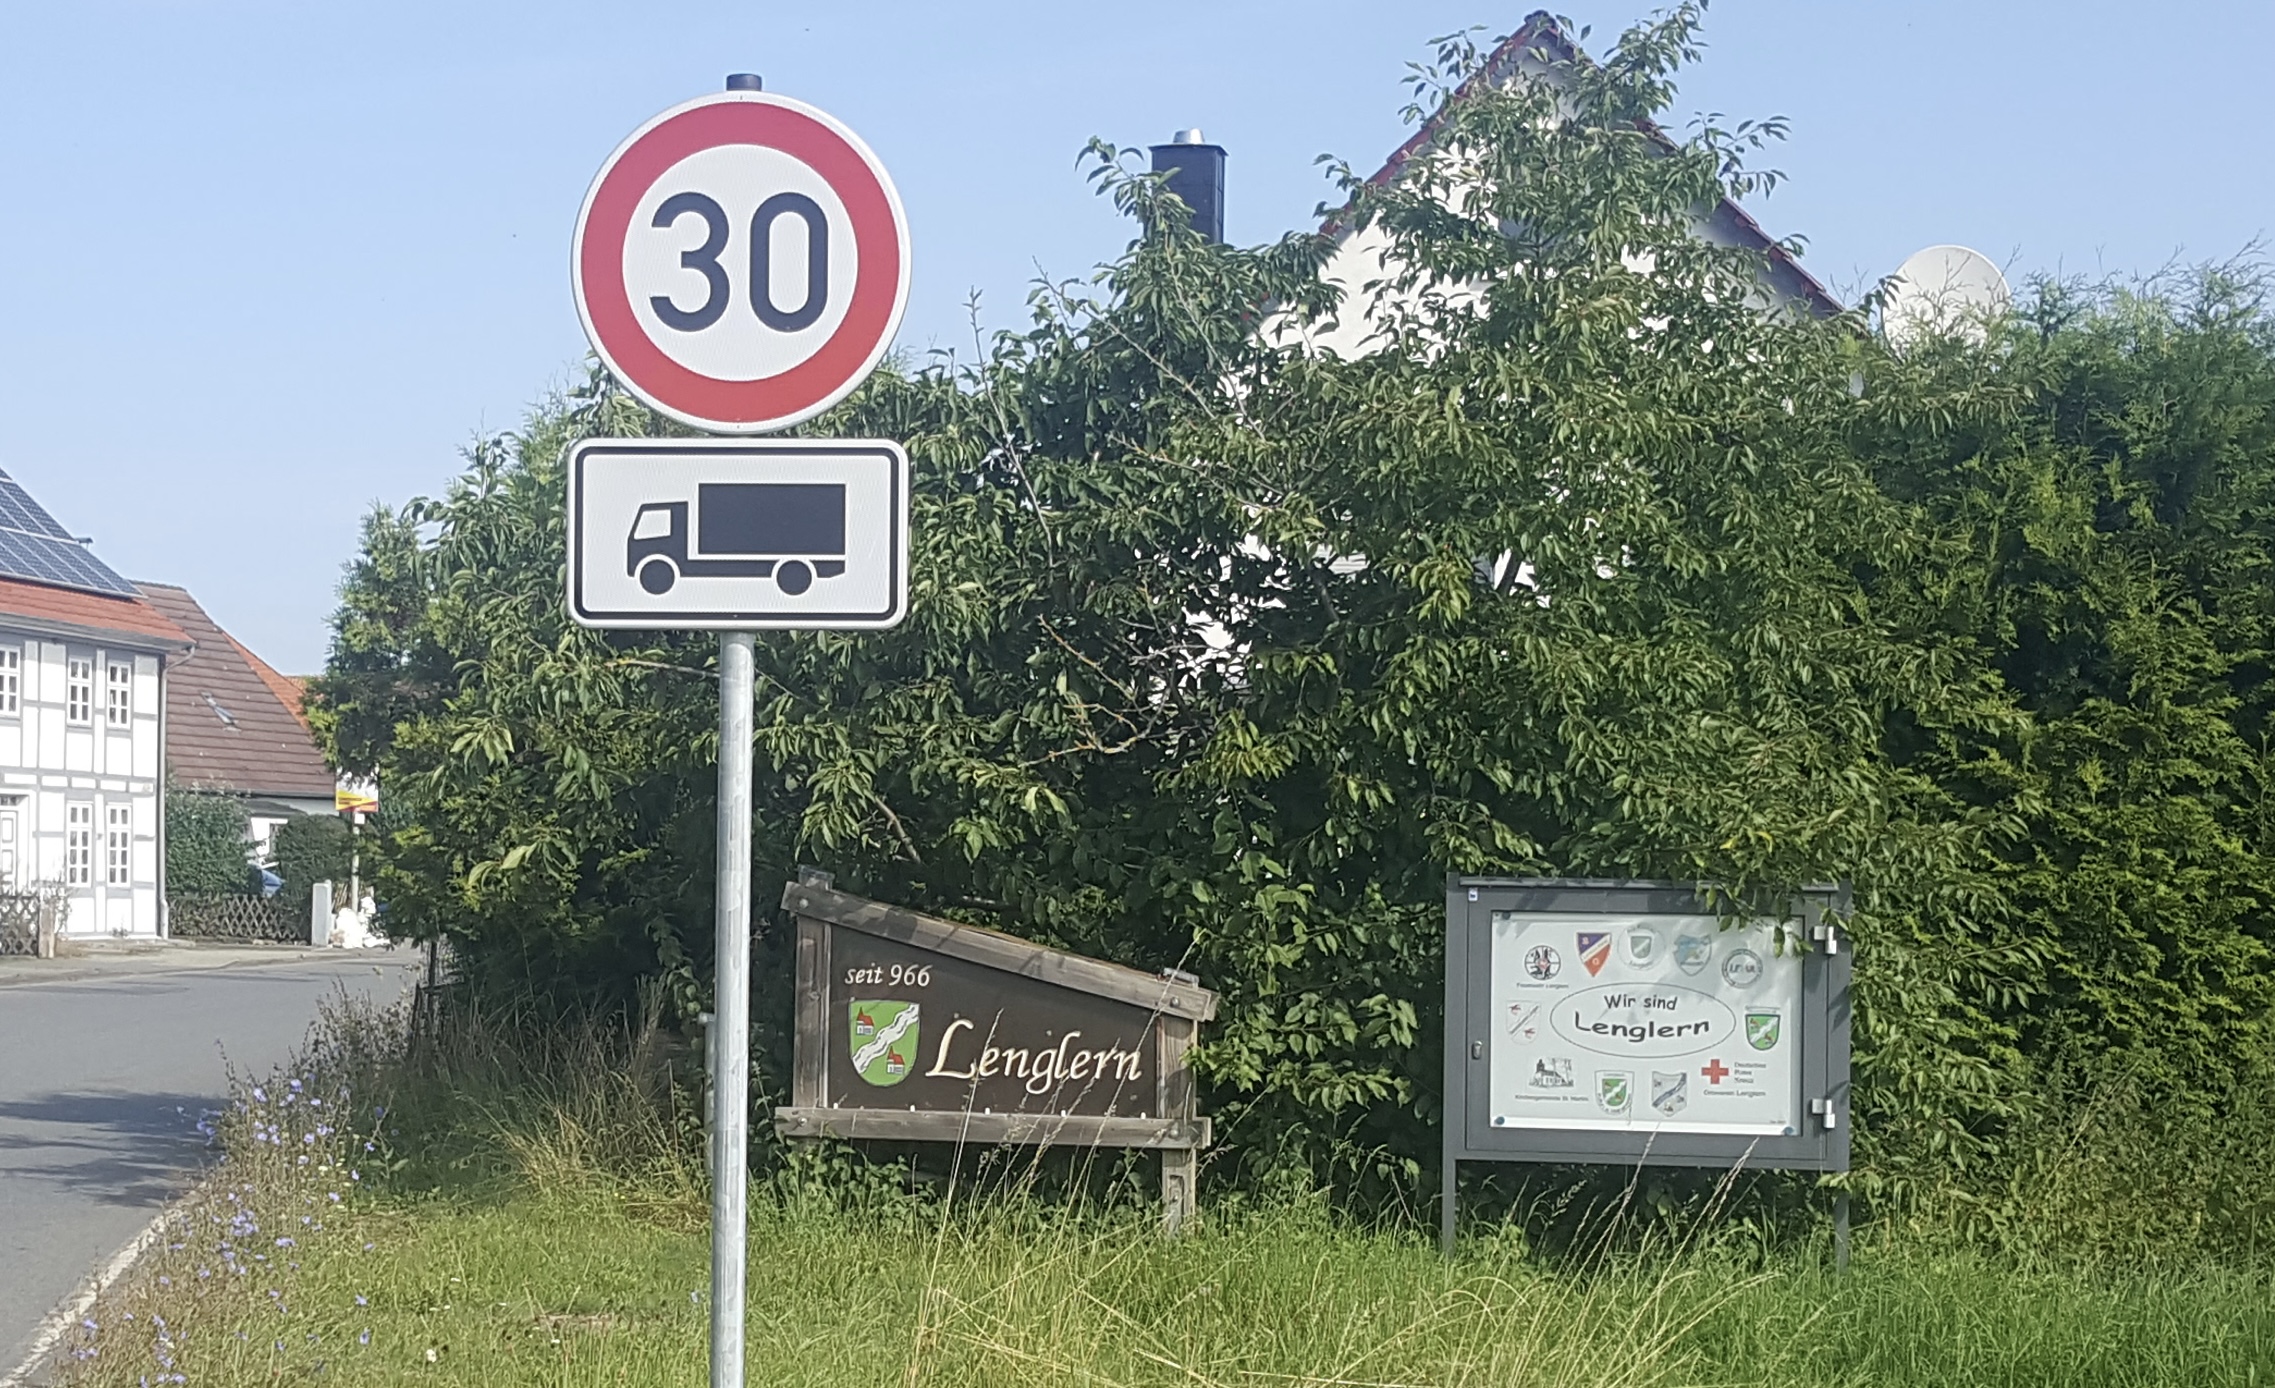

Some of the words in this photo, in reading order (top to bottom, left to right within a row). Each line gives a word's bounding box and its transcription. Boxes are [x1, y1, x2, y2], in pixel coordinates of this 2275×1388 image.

[649, 191, 829, 333] 30
[844, 964, 884, 986] seit
[889, 963, 931, 987] 966
[1604, 994, 1636, 1010] Wir
[1643, 995, 1679, 1011] sind
[1574, 1010, 1710, 1043] Lenglern
[925, 1017, 1143, 1095] Lenglern
